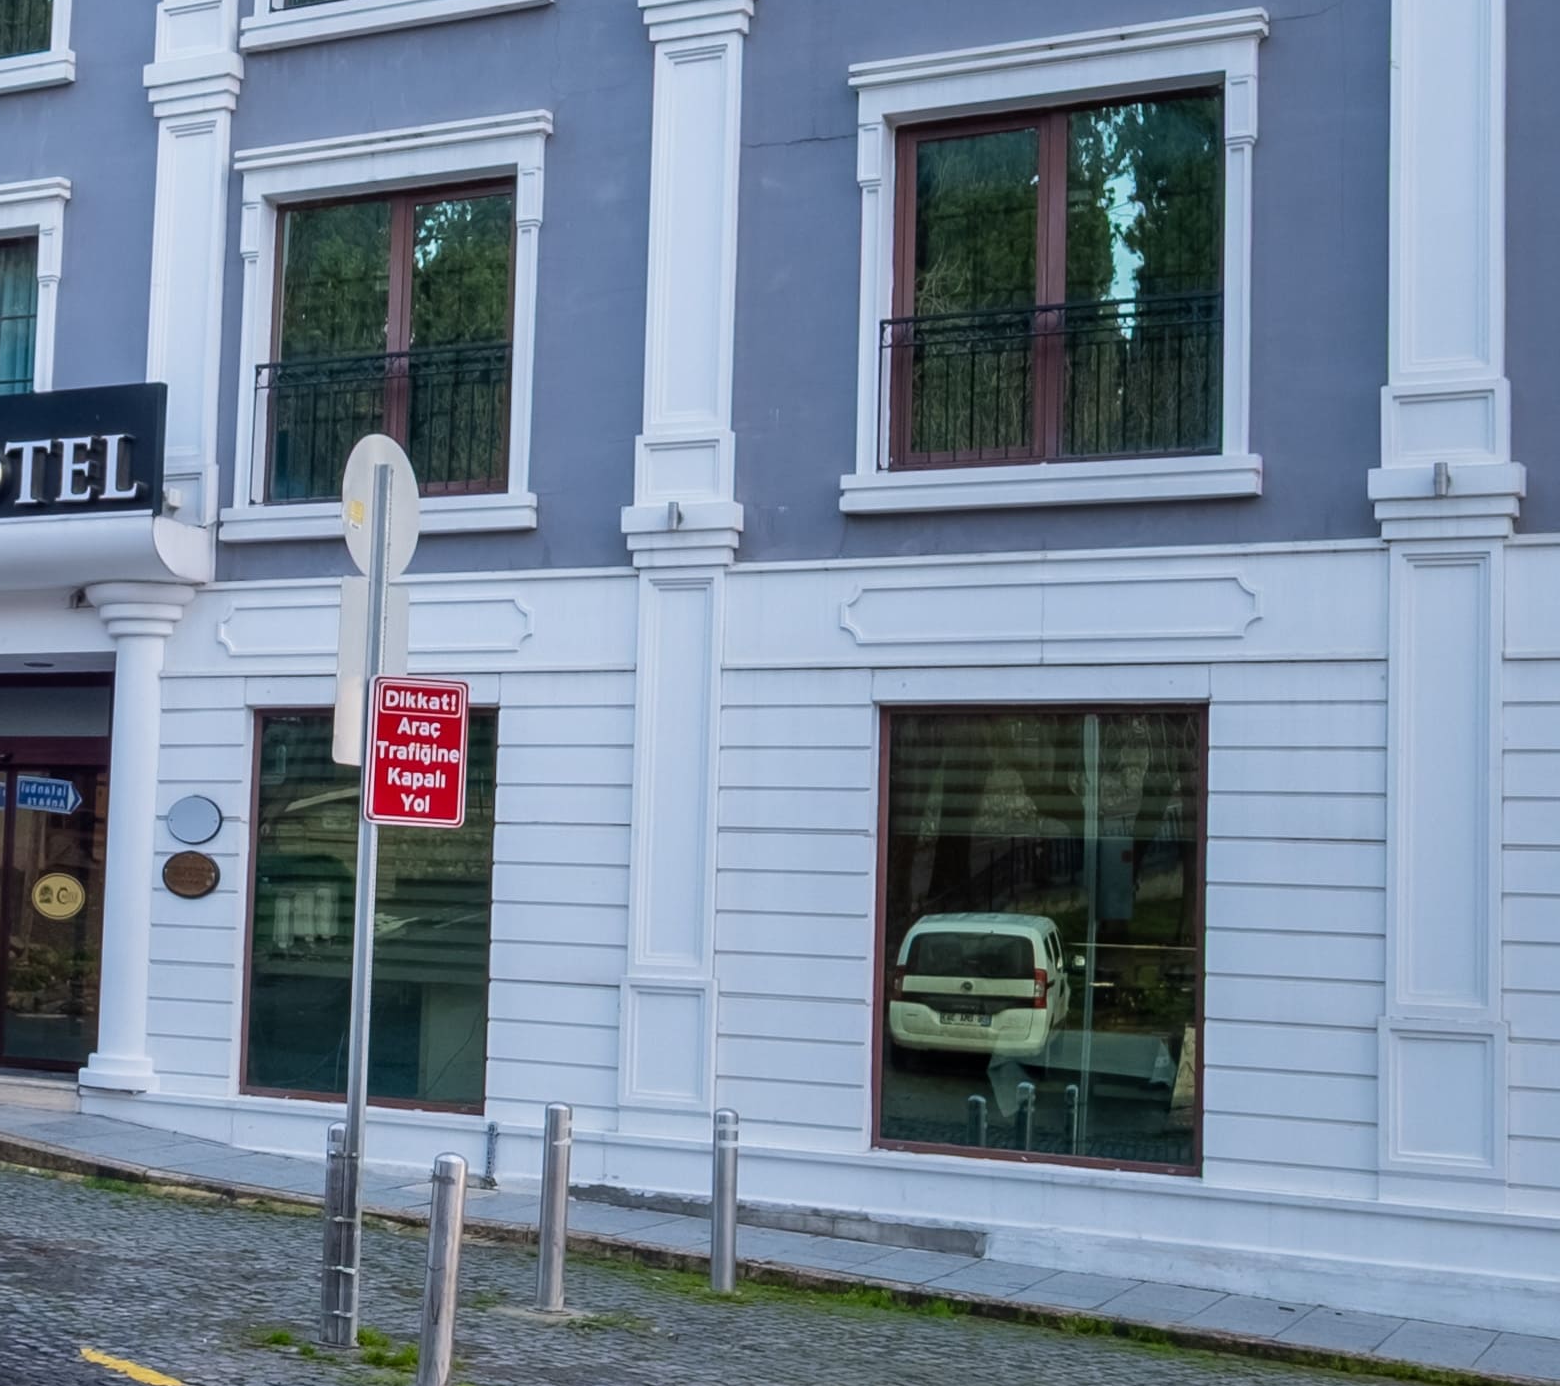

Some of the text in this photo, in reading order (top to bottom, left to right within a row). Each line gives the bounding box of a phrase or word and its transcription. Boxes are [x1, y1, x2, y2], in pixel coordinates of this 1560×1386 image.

[385, 690, 457, 712] Dikkat!
[397, 717, 441, 739] Araç
[377, 741, 460, 765] Trafiğine
[387, 767, 446, 790] Kapalı
[401, 793, 430, 813] Yol
